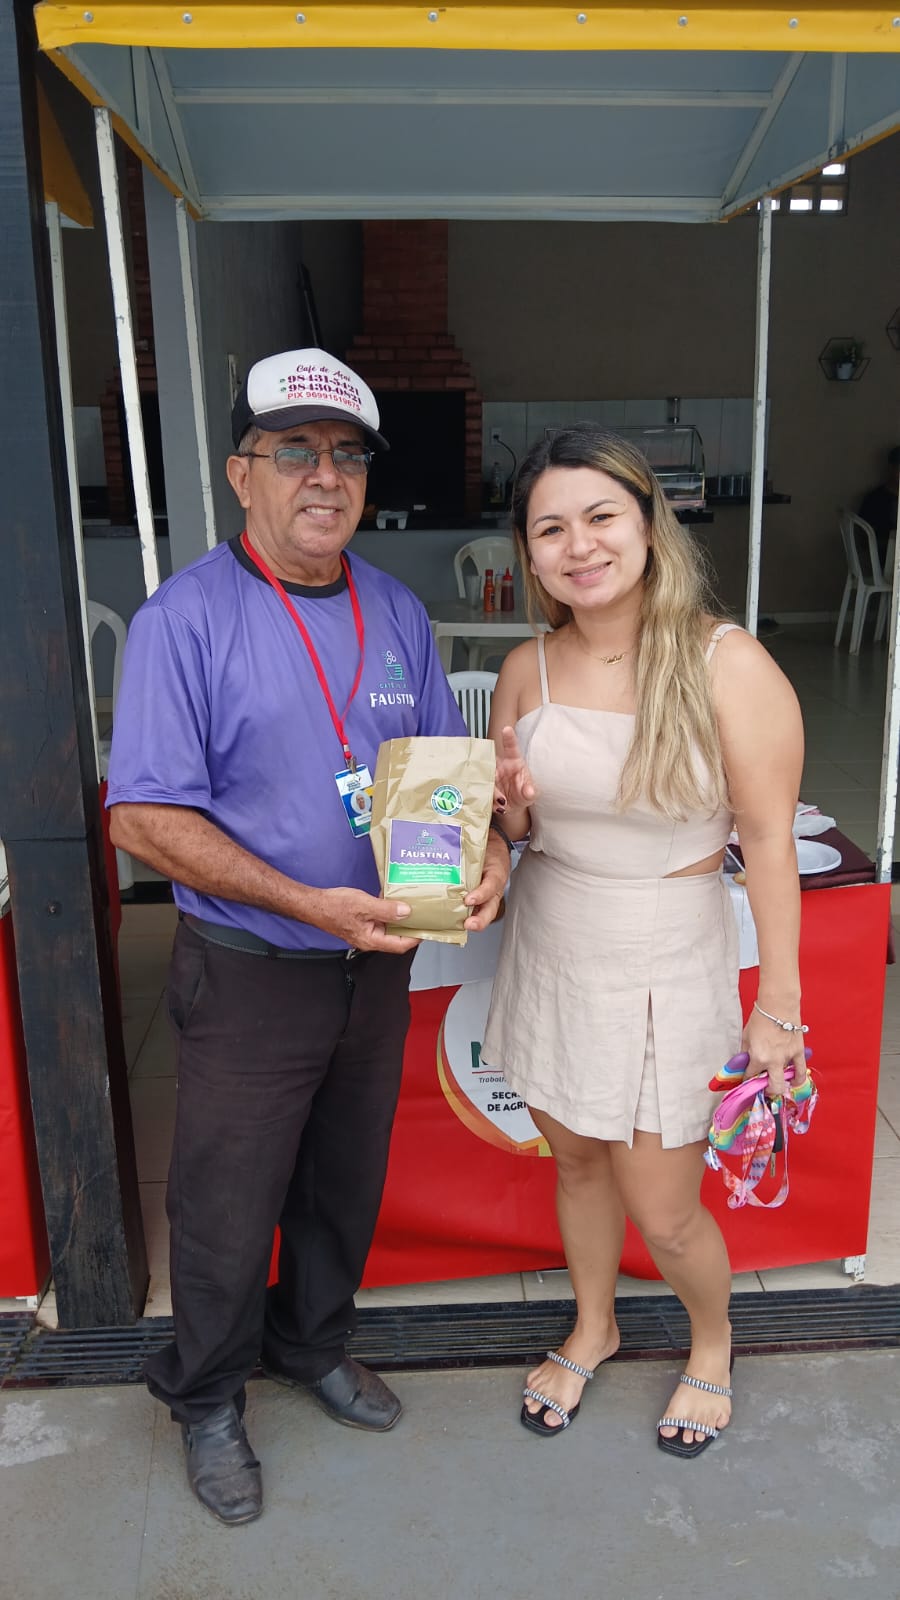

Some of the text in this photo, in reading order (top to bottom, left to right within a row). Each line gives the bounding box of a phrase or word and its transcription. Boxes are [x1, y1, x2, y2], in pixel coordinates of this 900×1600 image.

[296, 364, 317, 374] Café
[287, 391, 304, 401] PIX
[400, 849, 450, 861] FAUSTINA
[491, 1091, 521, 1100] SECR
[487, 1103, 501, 1112] DE
